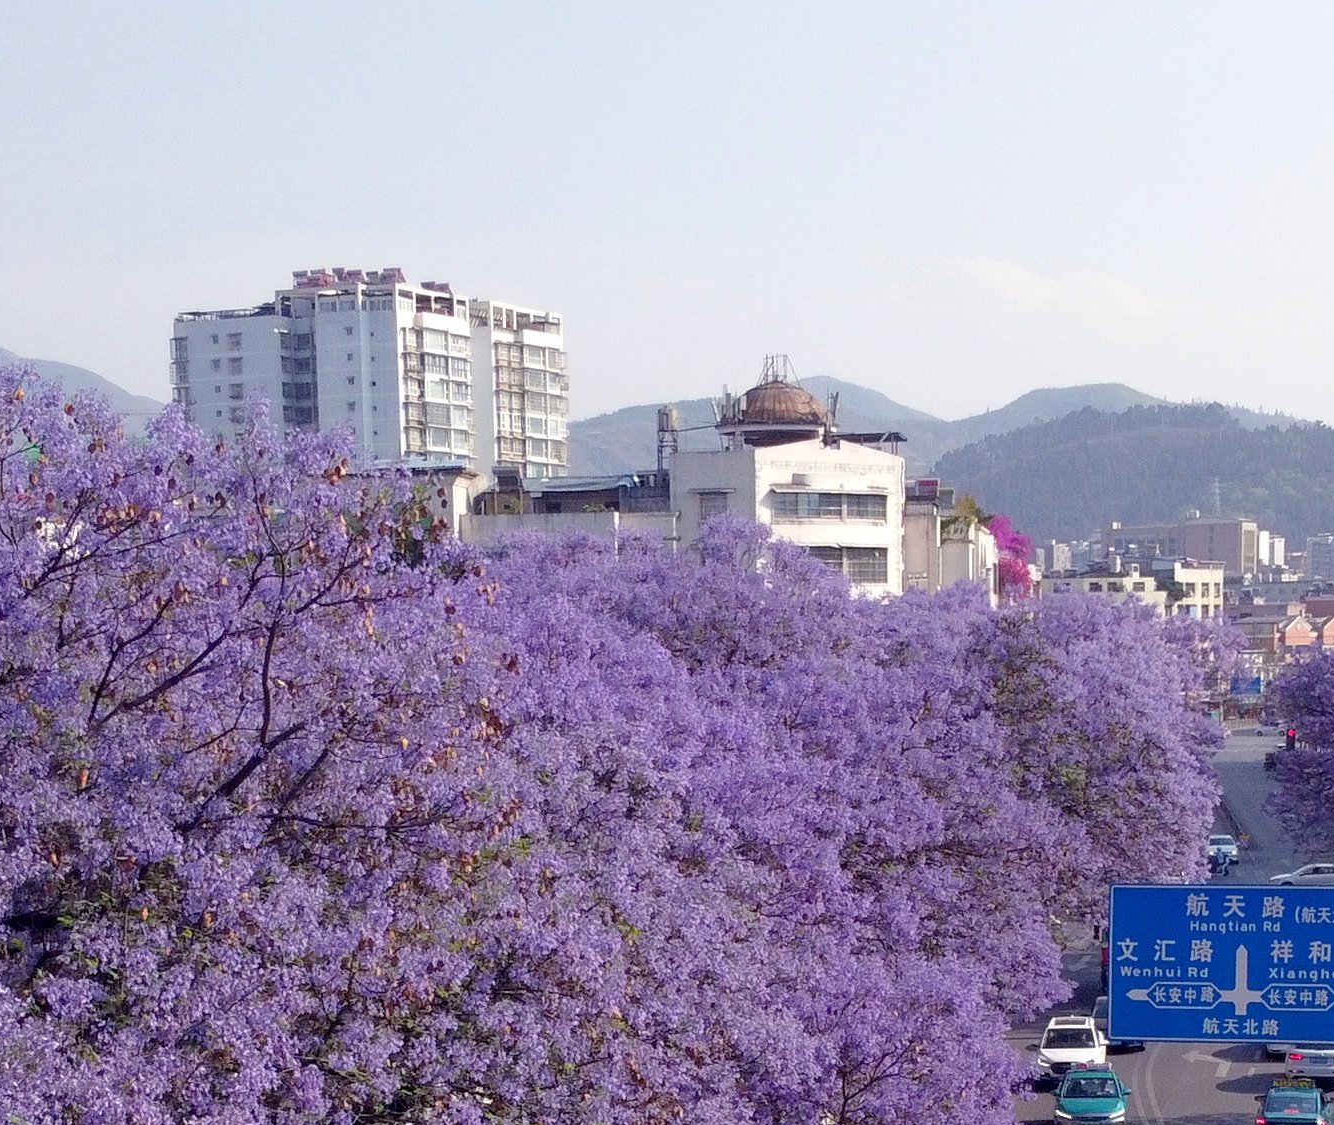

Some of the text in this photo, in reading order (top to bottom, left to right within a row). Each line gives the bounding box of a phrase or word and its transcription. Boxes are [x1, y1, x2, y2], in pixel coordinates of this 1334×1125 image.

[1185, 892, 1286, 919] 航天路
[1189, 920, 1281, 935] Hangtian Rd
[1116, 937, 1214, 962] 文汇路
[1120, 965, 1209, 978] Wenhui Rd
[1152, 986, 1215, 1004] 长安中路
[1267, 988, 1329, 1006] 长安中路
[1202, 1018, 1279, 1036] 航天北路
